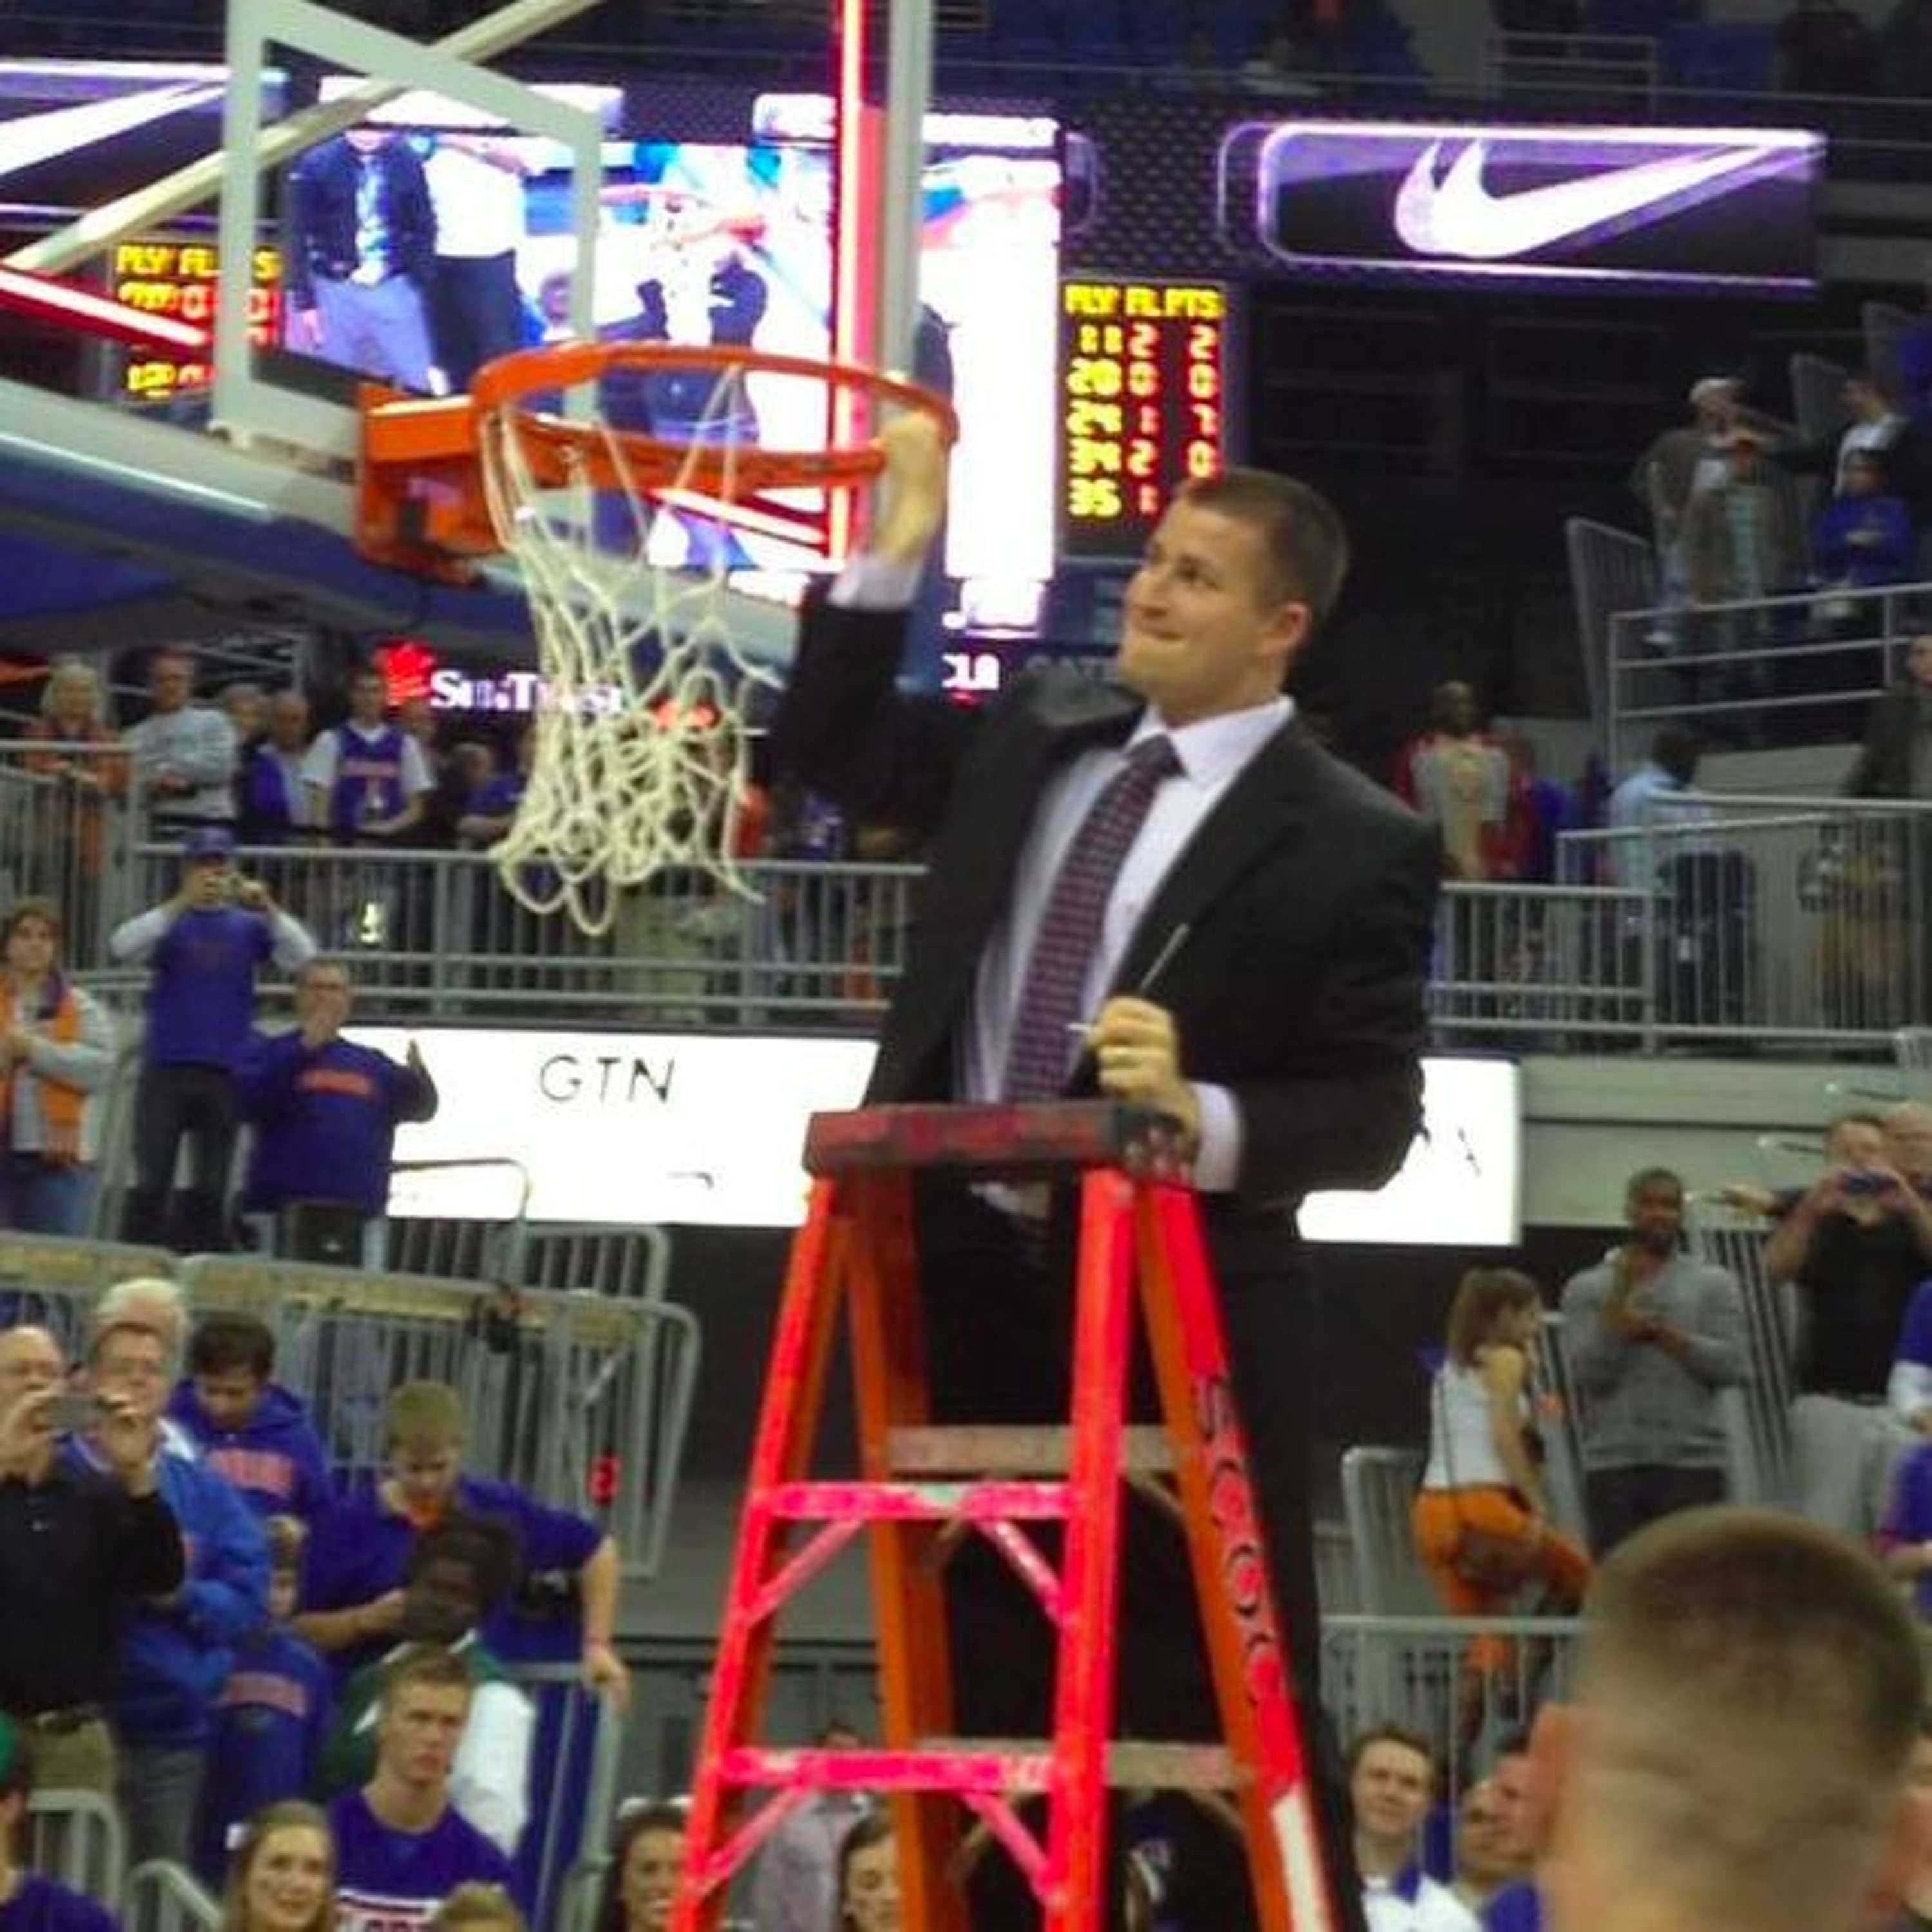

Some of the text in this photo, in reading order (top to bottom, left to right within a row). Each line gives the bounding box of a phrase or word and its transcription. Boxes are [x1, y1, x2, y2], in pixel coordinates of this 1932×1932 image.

[1164, 288, 1226, 318] PTS
[1128, 323, 1159, 358] 2
[1188, 325, 1217, 359] 2
[1128, 362, 1159, 396] 0
[1188, 363, 1218, 399] 0
[1127, 439, 1157, 477] 2
[1187, 440, 1216, 478] 0
[540, 1054, 676, 1102] GTN
